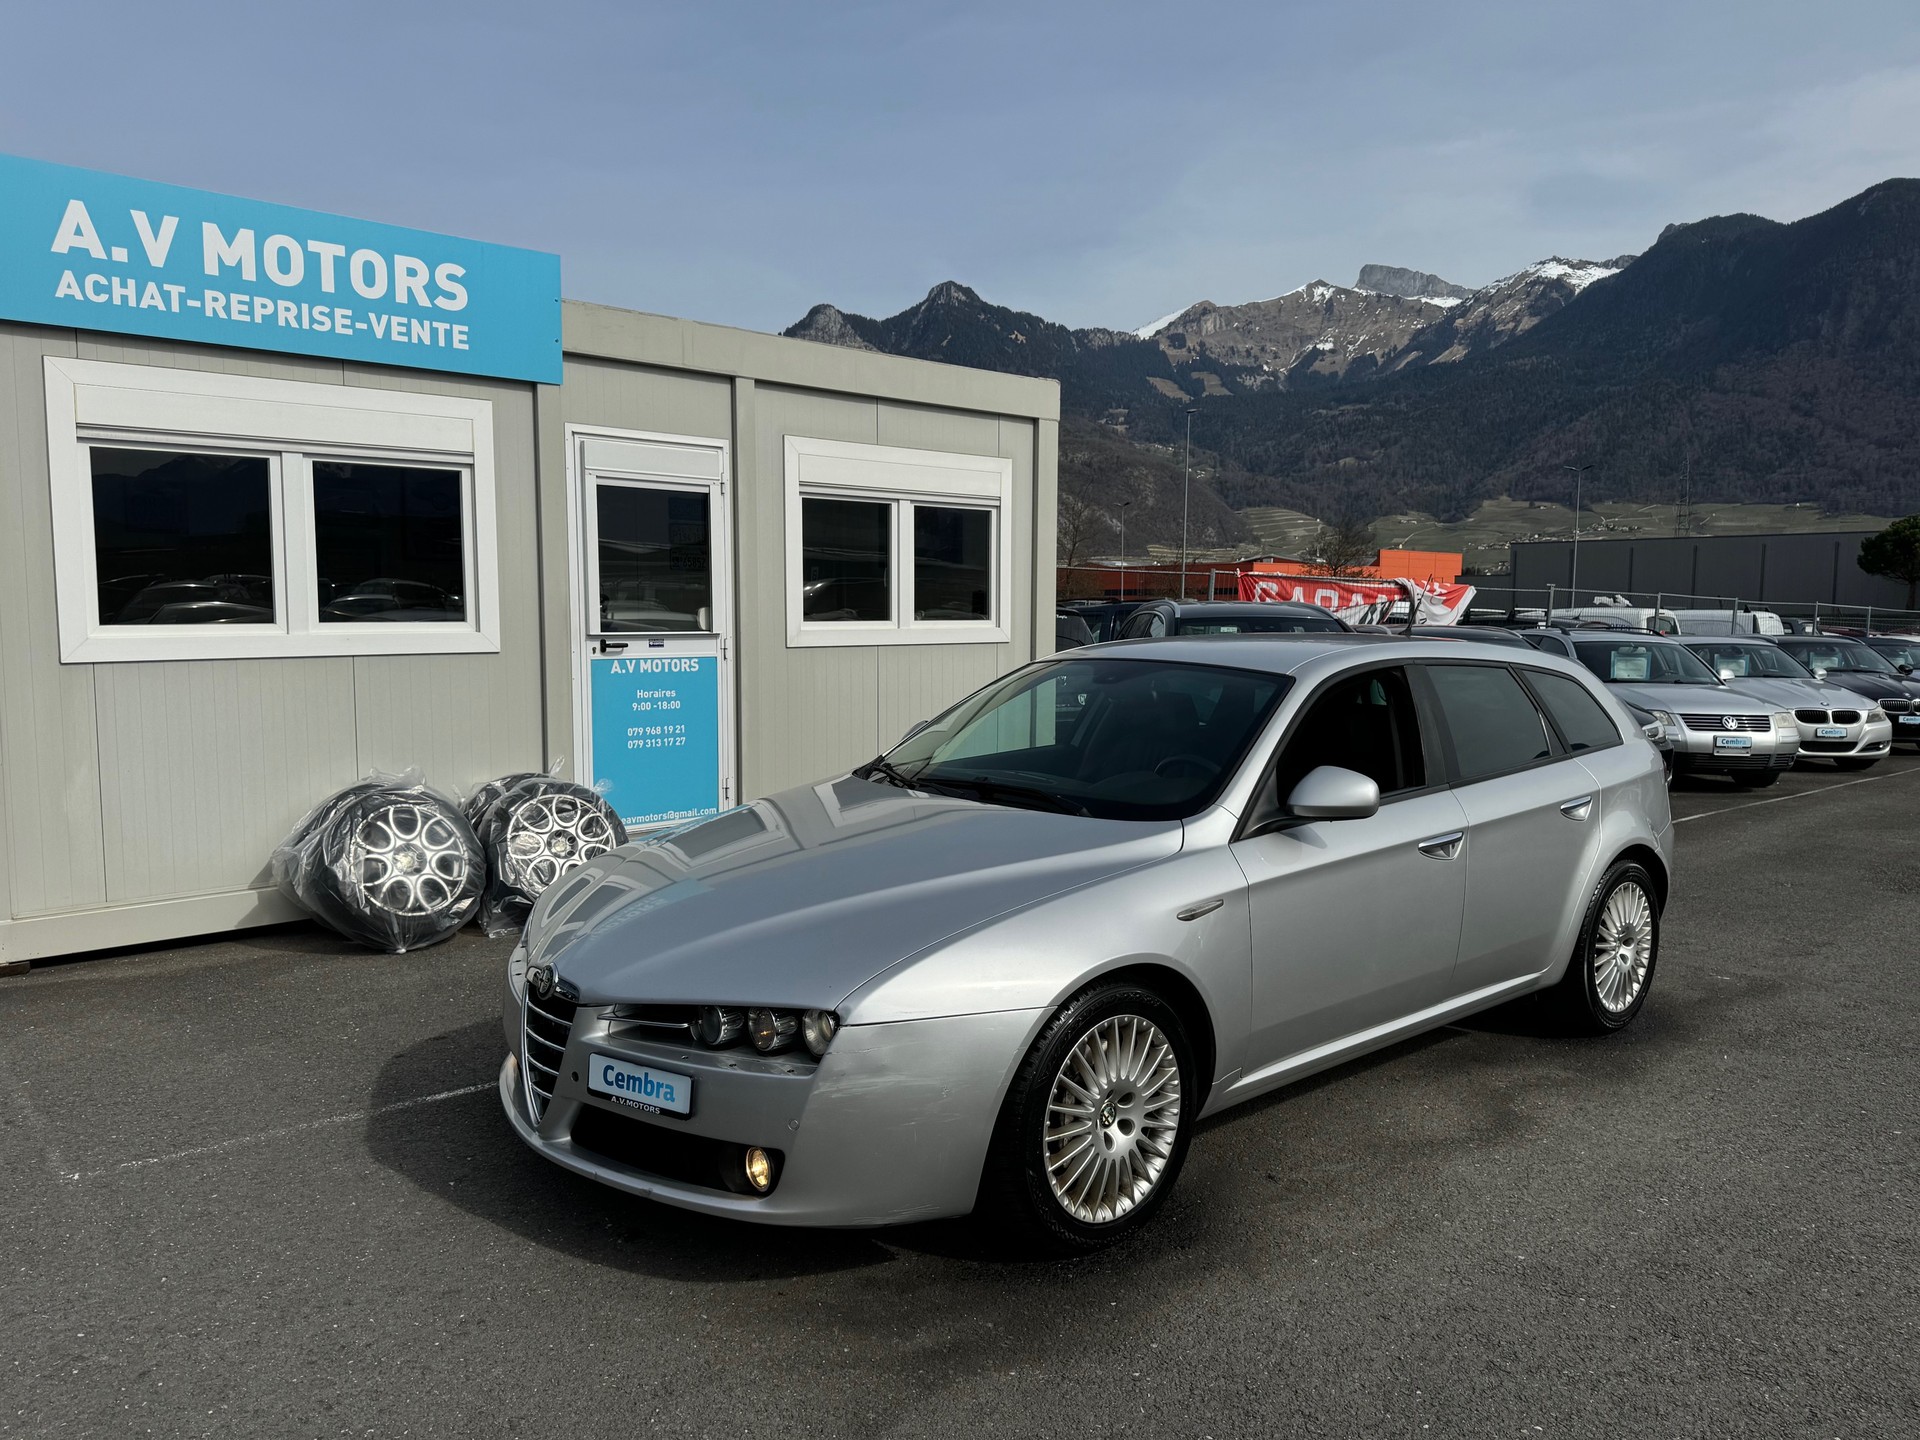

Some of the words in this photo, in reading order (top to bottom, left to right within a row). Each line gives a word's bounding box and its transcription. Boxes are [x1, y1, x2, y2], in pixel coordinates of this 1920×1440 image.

[50, 199, 180, 268] A.V
[201, 221, 470, 312] MOTORS
[55, 269, 470, 351] ACHAT-REPRISE-VENTE
[610, 659, 636, 674] A.V
[639, 658, 700, 673] MOTORS
[636, 688, 677, 699] Horaires
[631, 701, 652, 711] 9:00
[627, 727, 644, 737] 079
[645, 726, 662, 736] 968
[663, 725, 674, 734] 19
[675, 724, 686, 733] 21
[627, 739, 644, 749] 079
[645, 738, 662, 748] 313
[663, 737, 674, 746] 17
[675, 736, 686, 746] 27
[1721, 738, 1747, 746] Cembra
[621, 807, 717, 824] eavmotors@gmail.com
[602, 1064, 676, 1103] Cembra
[610, 1095, 661, 1115] A.V.MOTORS
